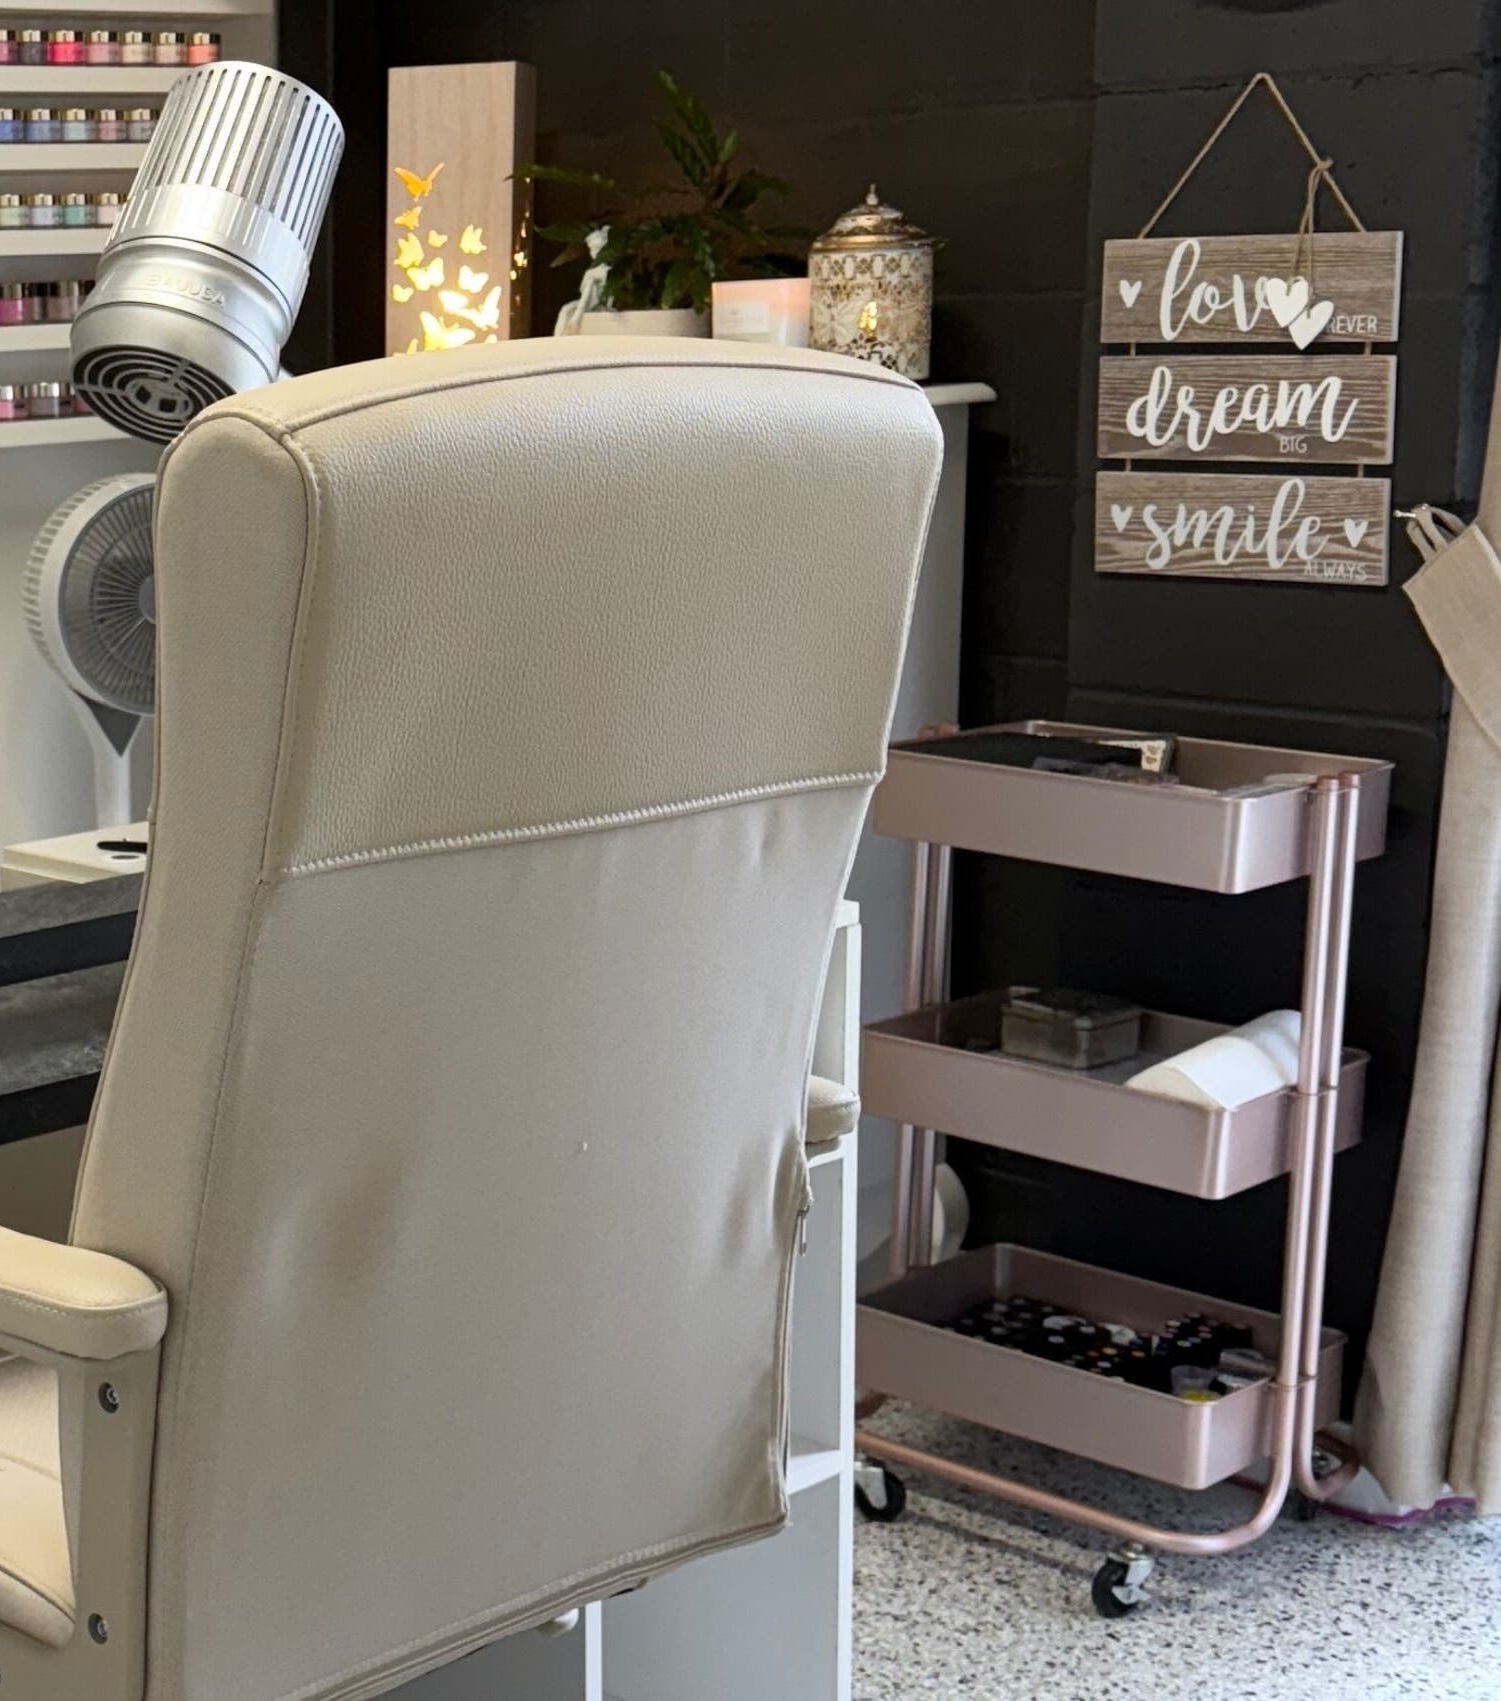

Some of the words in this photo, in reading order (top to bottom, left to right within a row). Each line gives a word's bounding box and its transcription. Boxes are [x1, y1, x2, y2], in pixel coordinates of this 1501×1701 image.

[1327, 314, 1378, 334] REVER
[1126, 366, 1358, 452] dream
[1280, 435, 1307, 453] BIG
[1142, 478, 1330, 569] smile
[1304, 560, 1369, 581] ALWAYS
